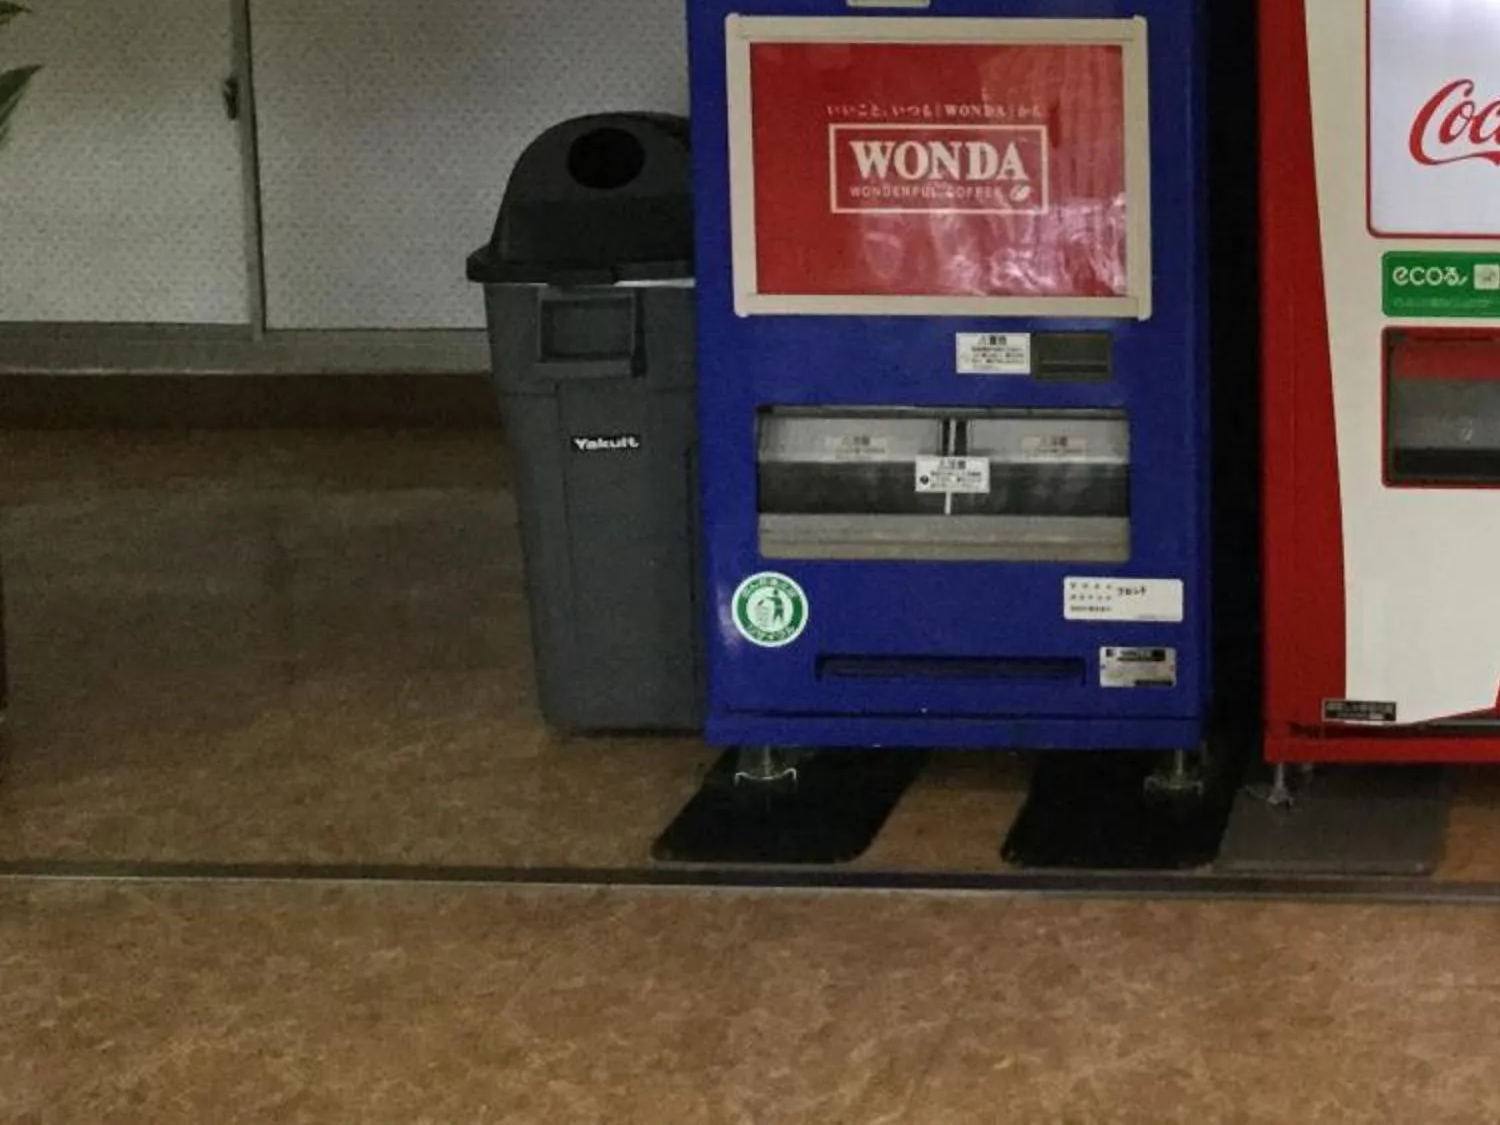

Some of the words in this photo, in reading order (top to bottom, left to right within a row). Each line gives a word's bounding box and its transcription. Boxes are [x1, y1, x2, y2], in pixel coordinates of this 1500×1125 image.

[848, 141, 1030, 181] WONDA
[851, 186, 937, 199] WONDERFUL
[574, 436, 640, 450] Yakult
